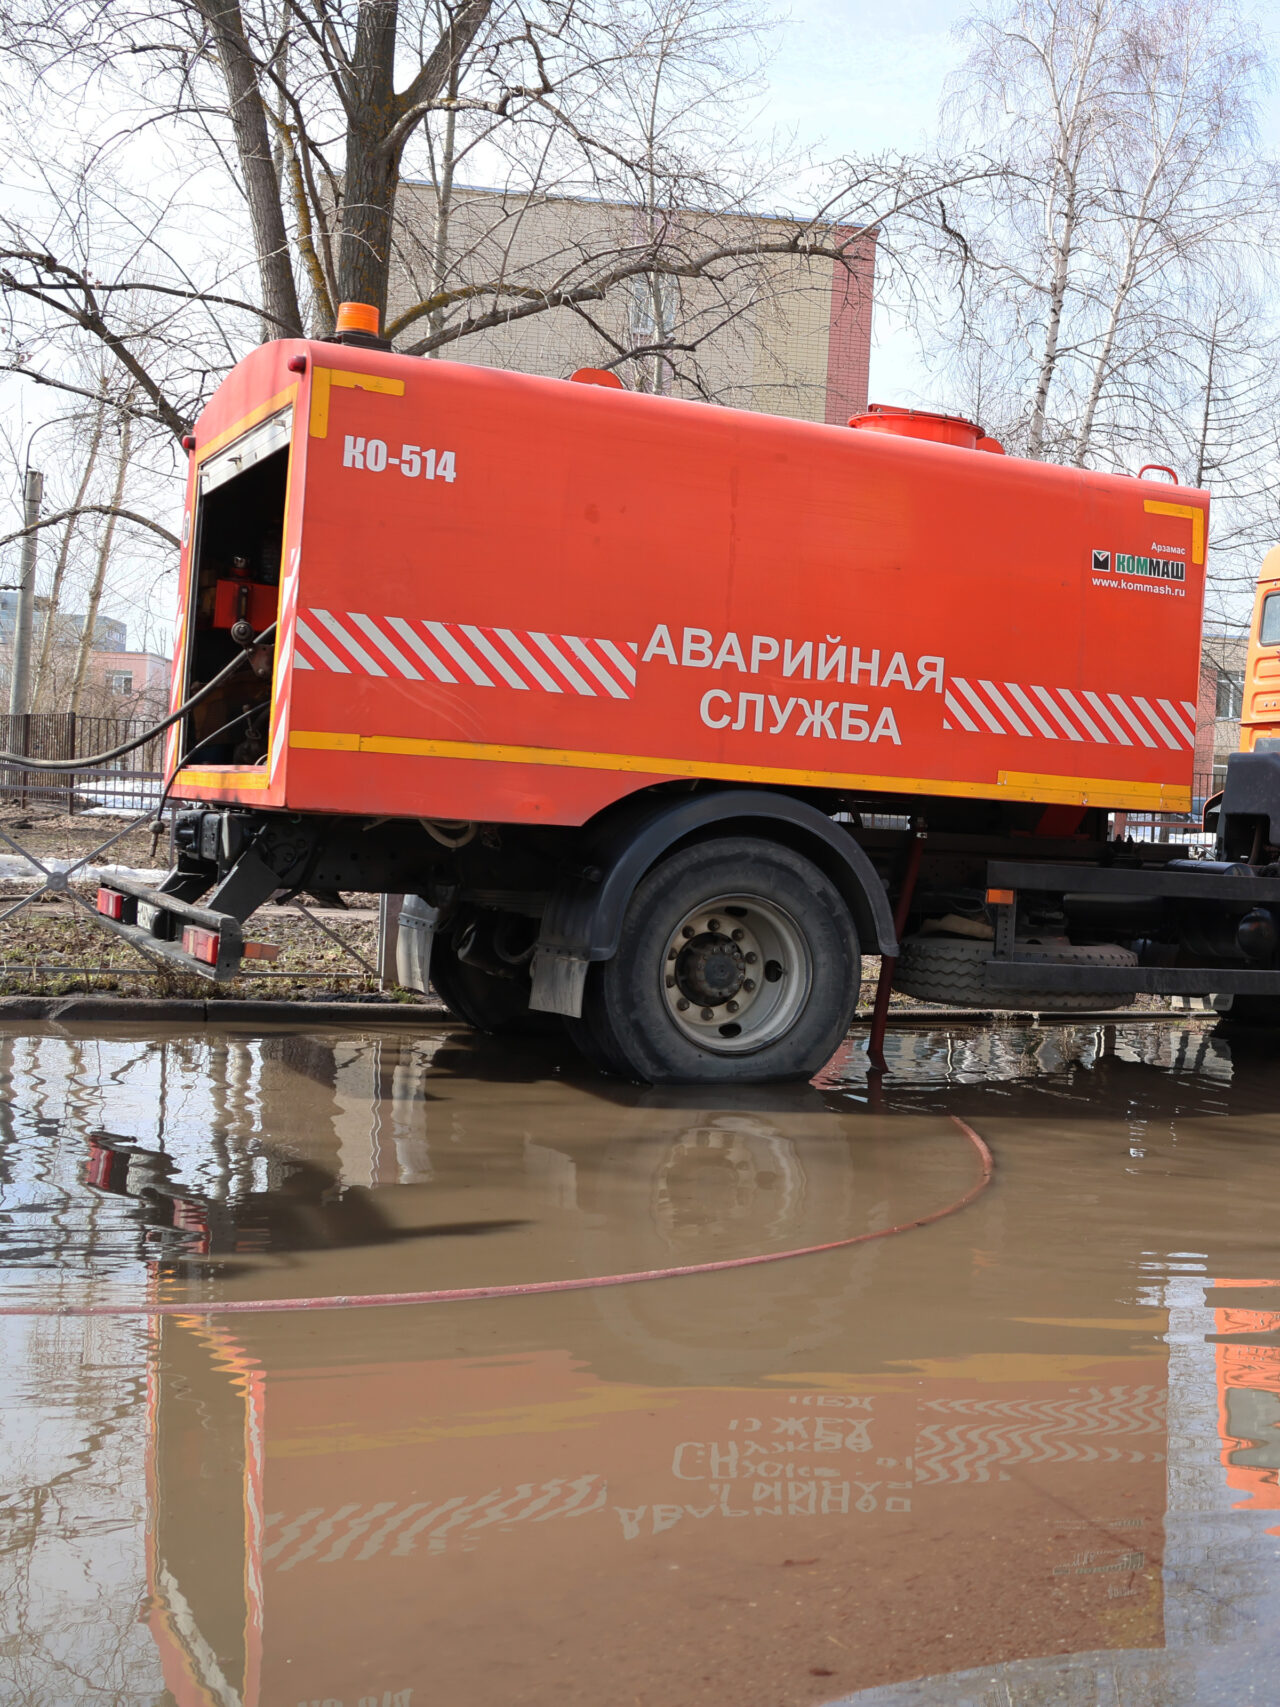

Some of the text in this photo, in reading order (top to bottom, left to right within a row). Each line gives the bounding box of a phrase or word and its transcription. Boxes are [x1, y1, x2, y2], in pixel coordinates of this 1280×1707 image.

[343, 435, 457, 483] КО-514
[1115, 553, 1185, 582] КОММАШ
[1151, 542, 1186, 555] Арзамас
[1092, 577, 1185, 597] www.kommash.ru
[641, 624, 945, 694] АВАРИЙНАЯ
[700, 689, 902, 745] СЛУЖБА
